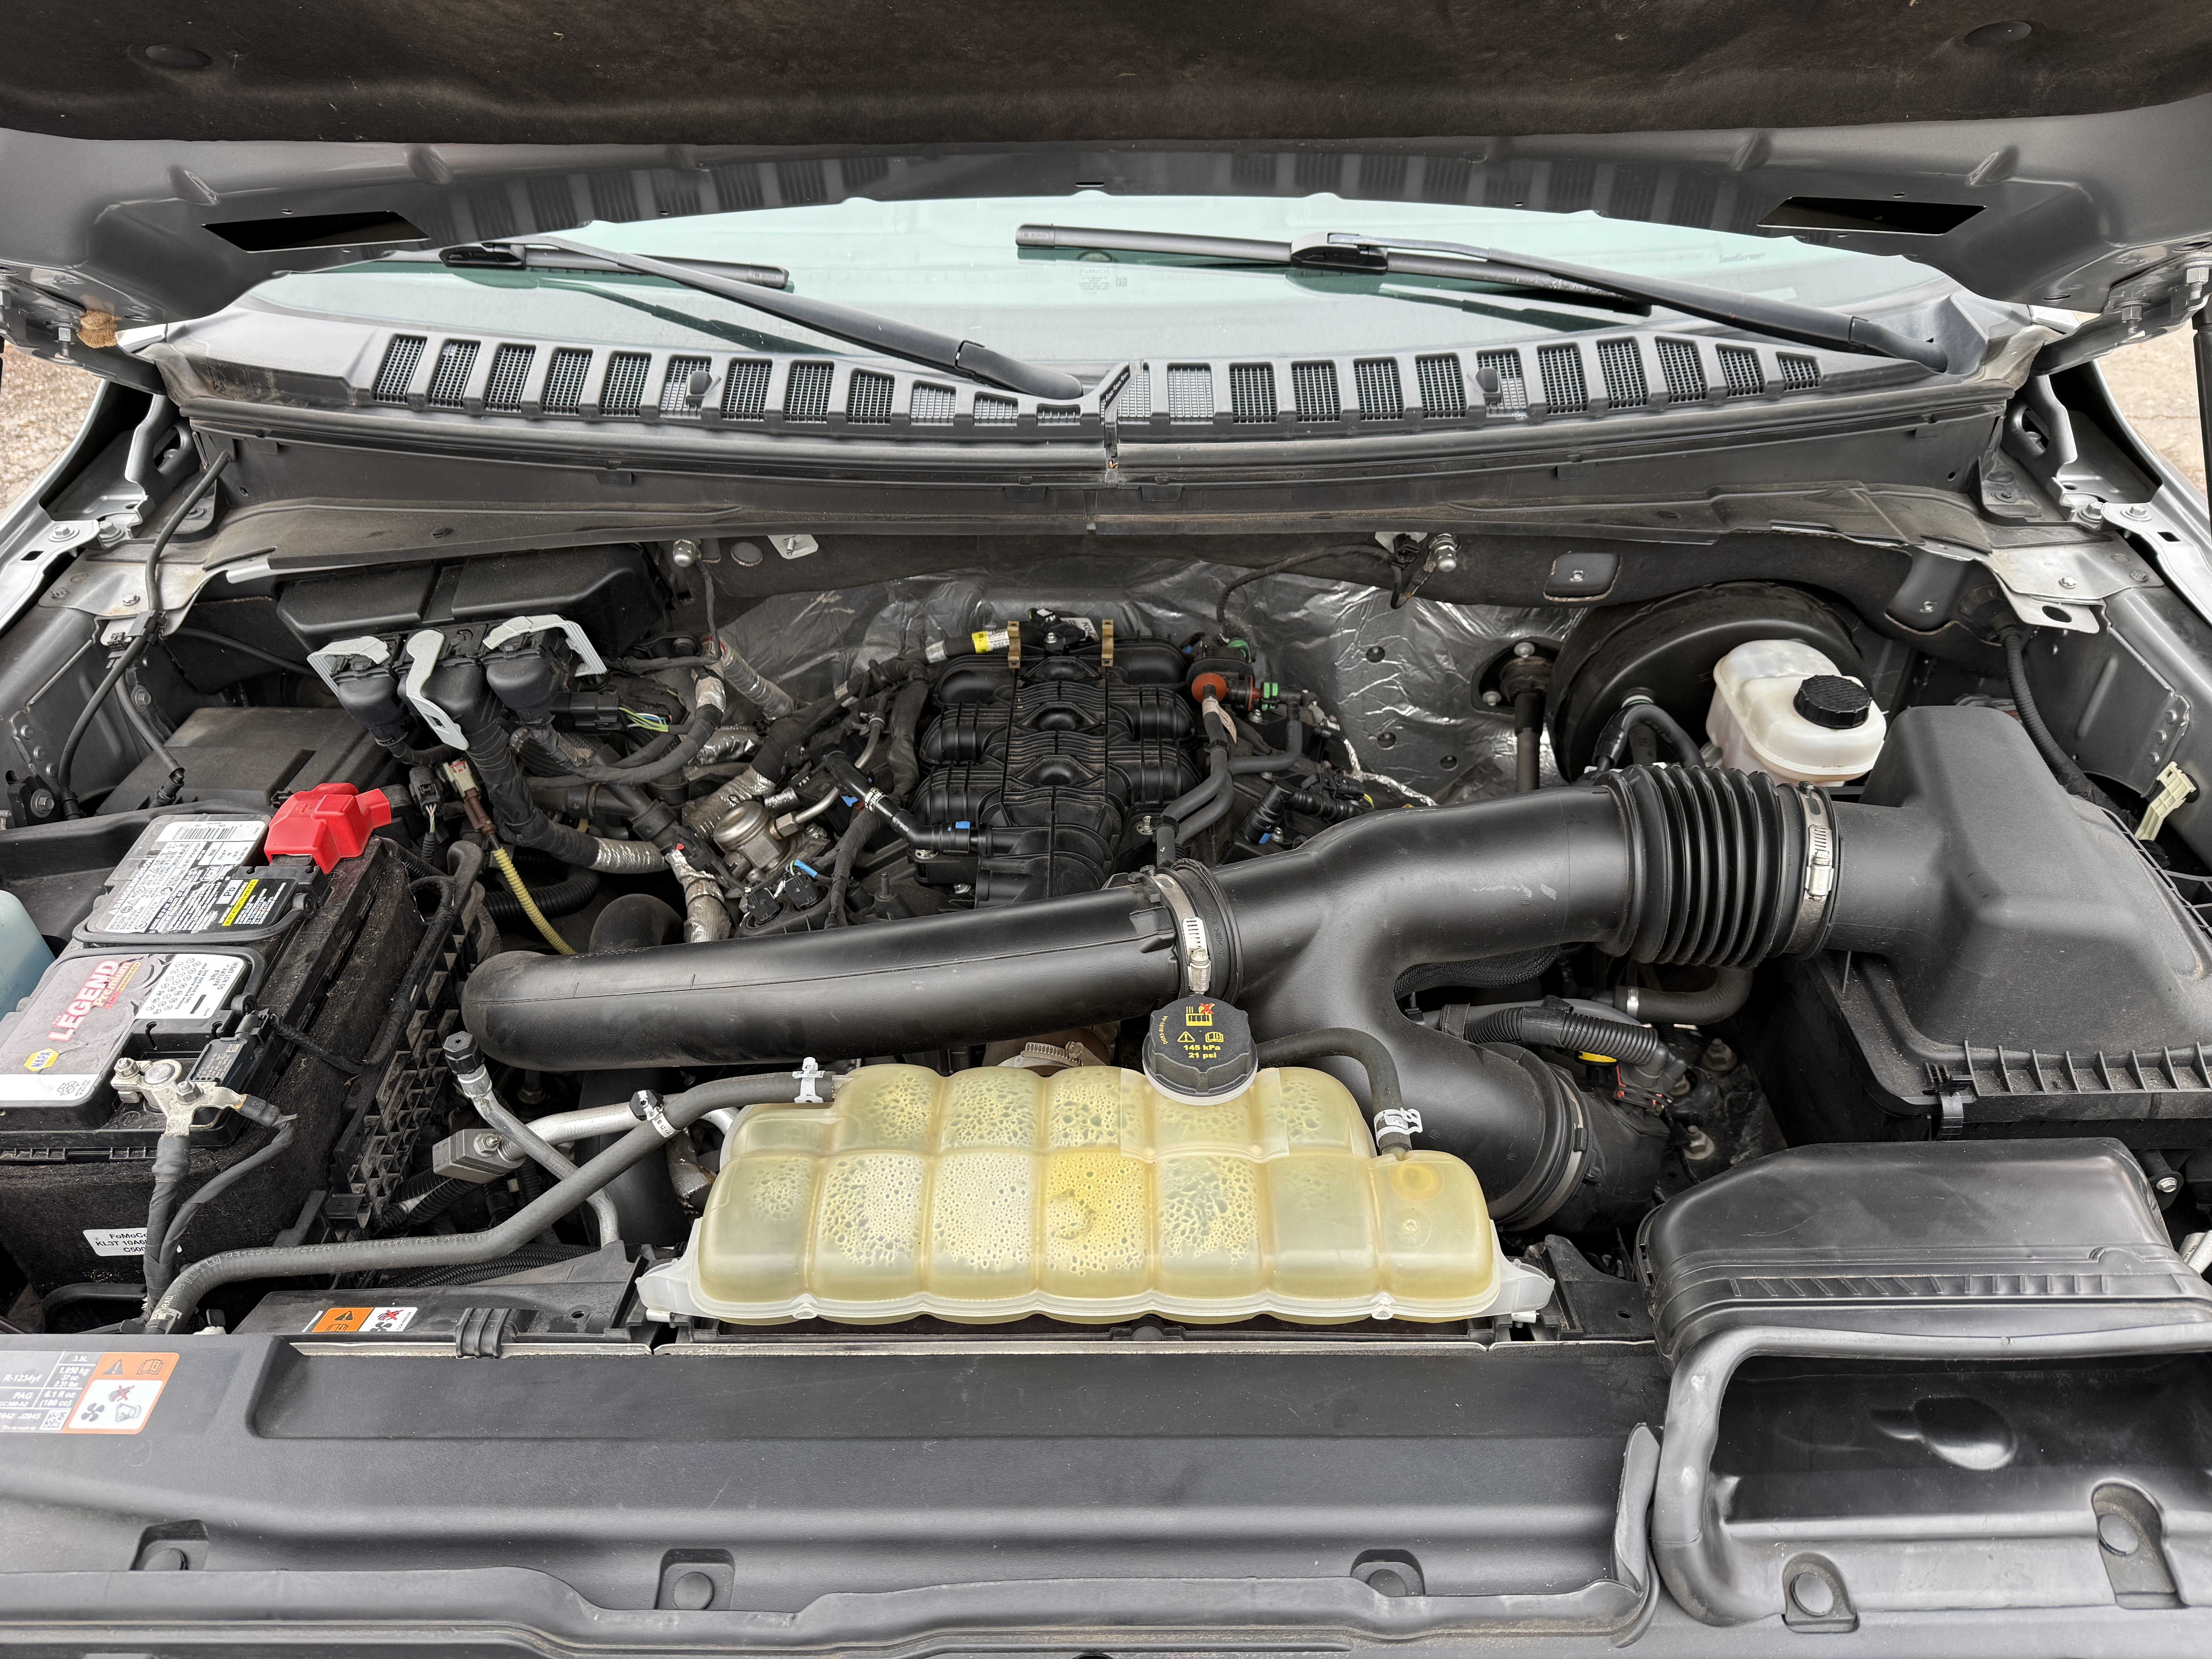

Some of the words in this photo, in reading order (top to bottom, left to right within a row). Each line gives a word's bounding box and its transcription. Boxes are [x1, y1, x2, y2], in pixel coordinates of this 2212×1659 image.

[223, 887, 235, 896] Pb
[118, 962, 140, 992] TECHNOLOGY
[208, 969, 221, 980] VRLA
[212, 968, 228, 986] BATTERY
[46, 960, 120, 1042] LEGEND
[31, 1051, 52, 1067] NAPA
[226, 1249, 283, 1257] 03/23/21
[79, 1367, 90, 1376] kg
[3, 1374, 43, 1383] R-1234yf
